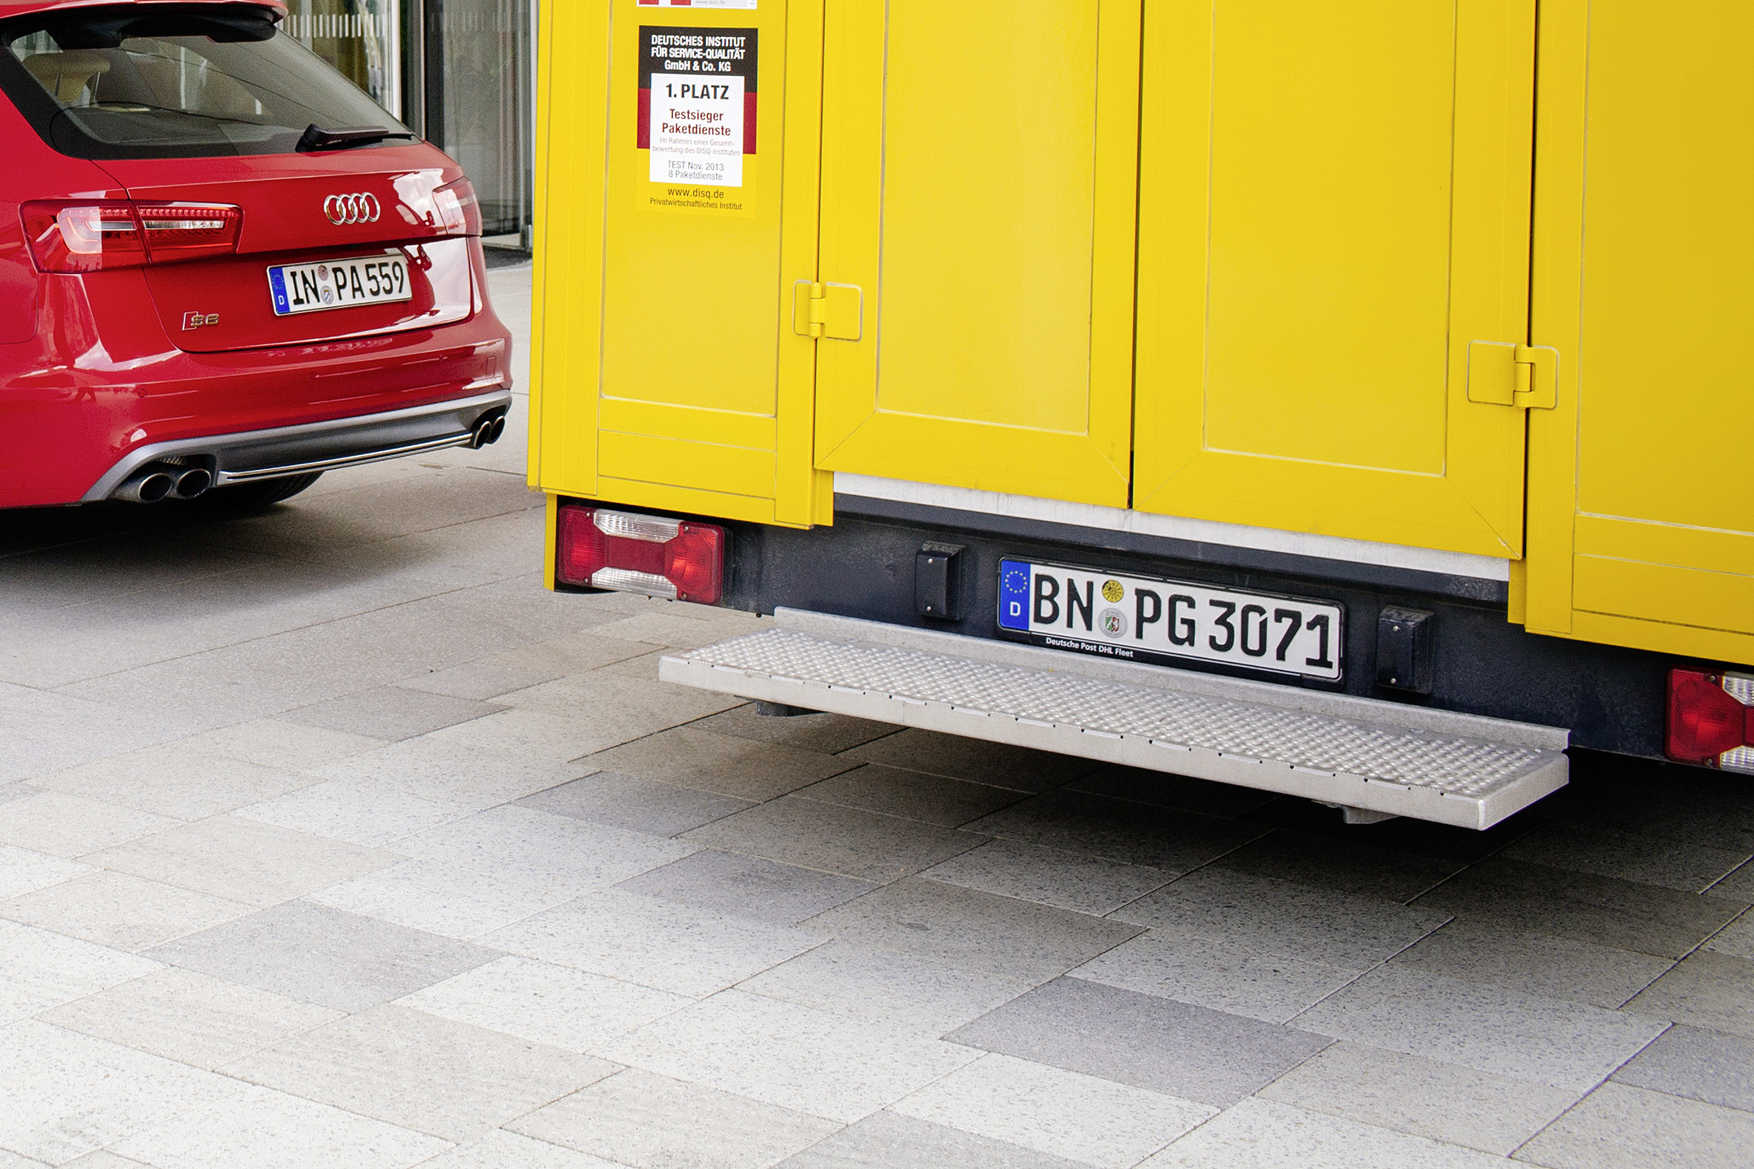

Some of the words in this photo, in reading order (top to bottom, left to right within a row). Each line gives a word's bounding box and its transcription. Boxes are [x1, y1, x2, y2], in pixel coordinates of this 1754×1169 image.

[651, 34, 703, 46] DEUTSCHES
[706, 36, 746, 47] INSTITUT
[651, 46, 668, 57] FÜR
[669, 47, 746, 59] SERVICE-QUALITÄT
[664, 60, 691, 71] GmbH
[692, 61, 700, 71] &
[702, 61, 716, 71] Co.
[718, 61, 731, 71] KG
[666, 83, 677, 98] 1.
[681, 84, 729, 100] PLATZ
[670, 109, 724, 123] Testsieger
[662, 122, 731, 136] Paketdienste
[667, 160, 685, 169] TEST
[688, 161, 703, 170] Nov.
[705, 162, 724, 171] 2013
[675, 170, 723, 181] Paketdienste
[667, 188, 724, 199] www.disq.de
[649, 197, 718, 209] Privatwirtschaftliches
[720, 200, 742, 210] Institut
[290, 269, 321, 305] IN
[332, 265, 365, 300] PA
[365, 261, 404, 296] 559
[1009, 601, 1021, 616] D
[1033, 573, 1094, 631] BN
[1135, 587, 1196, 647] PG
[1208, 599, 1334, 669] 3071
[1046, 637, 1079, 649] Deutsche
[1080, 642, 1097, 651] Post
[1098, 645, 1114, 654] DHL
[1115, 648, 1133, 657] Fleet
